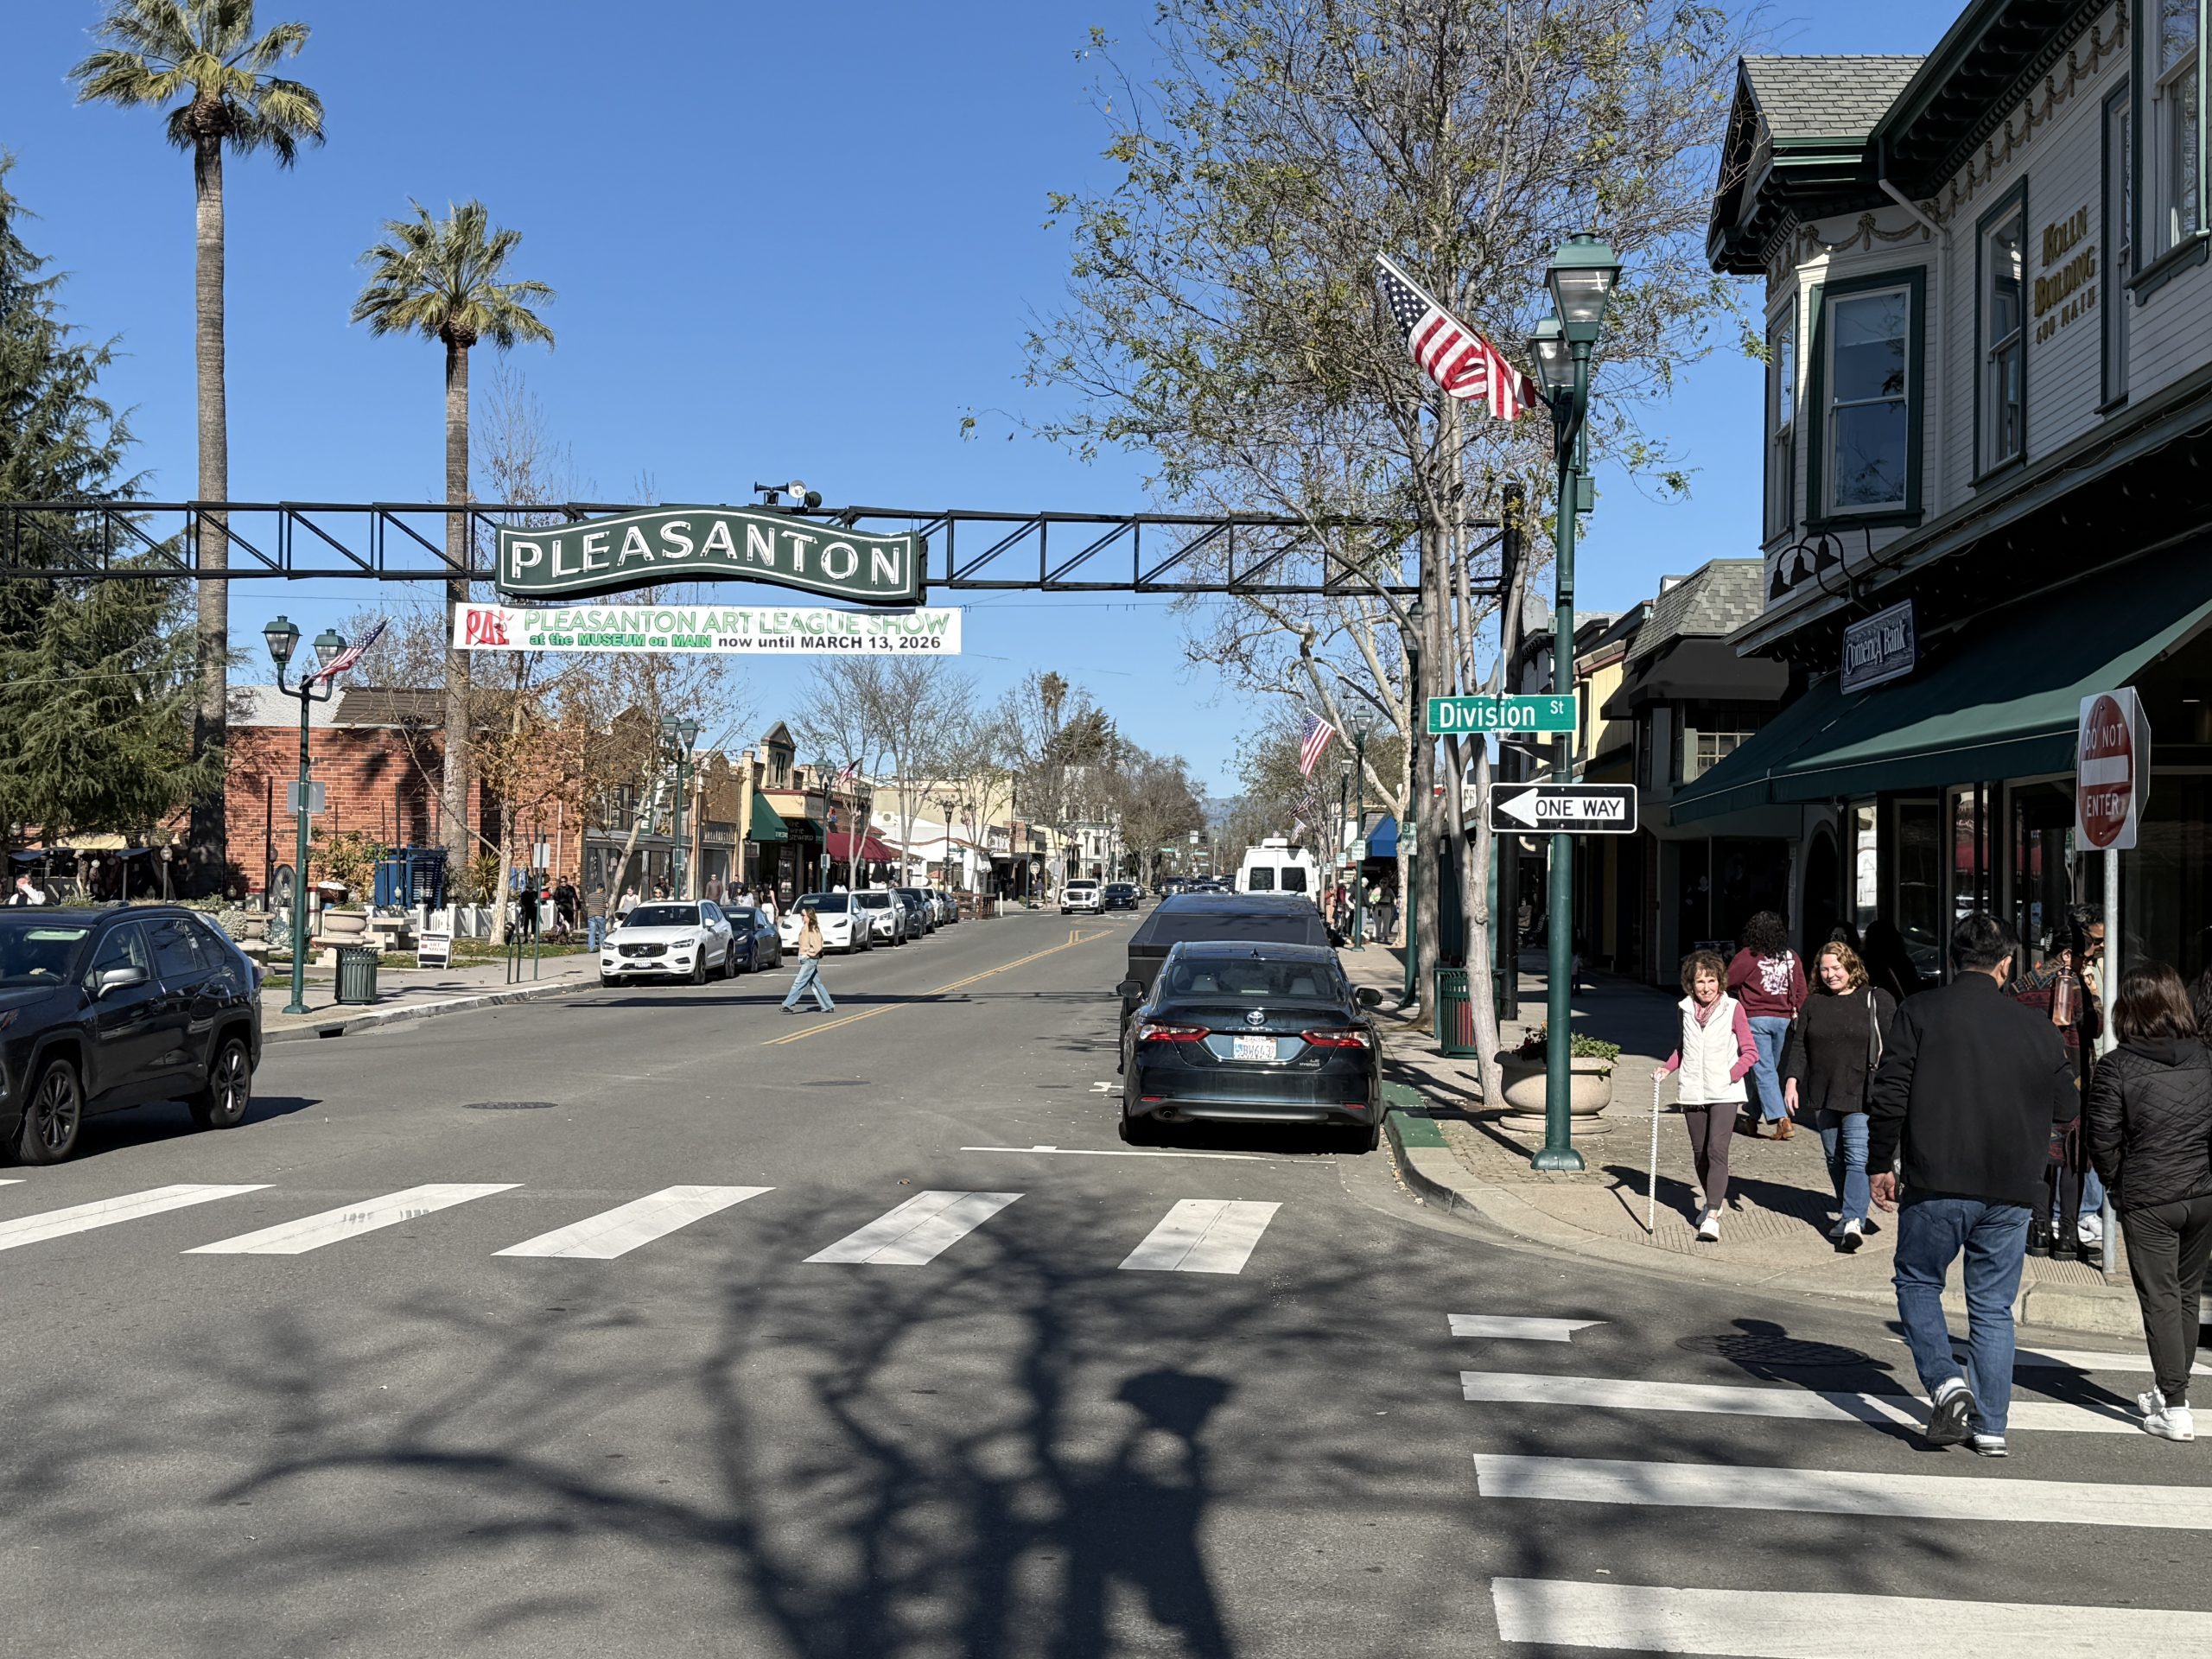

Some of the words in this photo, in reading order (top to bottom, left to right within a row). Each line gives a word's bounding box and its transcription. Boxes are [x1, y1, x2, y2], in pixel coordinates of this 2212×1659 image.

[2034, 245, 2095, 318] BUILDING
[2061, 286, 2096, 327] MAIN
[512, 519, 900, 585] PLEASANTON
[524, 610, 696, 632] PLEASANTON
[702, 611, 753, 634] ART
[759, 612, 861, 635] LEAGUE
[866, 612, 950, 635] SHOW
[529, 632, 546, 646] at
[549, 632, 575, 646] the
[577, 633, 646, 647] MUSEUM
[649, 635, 668, 647] on
[671, 633, 712, 648] MAIN
[718, 637, 753, 648] now
[758, 636, 795, 649] until
[800, 636, 862, 649] MARCH
[868, 636, 893, 652] 13,
[899, 636, 941, 649] 2026
[1439, 702, 1536, 728] Division
[1549, 701, 1565, 715] St
[2085, 728, 2097, 751] DO
[2102, 723, 2124, 749] NOT
[1535, 799, 1574, 817] ONE
[1583, 799, 1621, 817] WAY
[2087, 793, 2120, 818] ENTER
